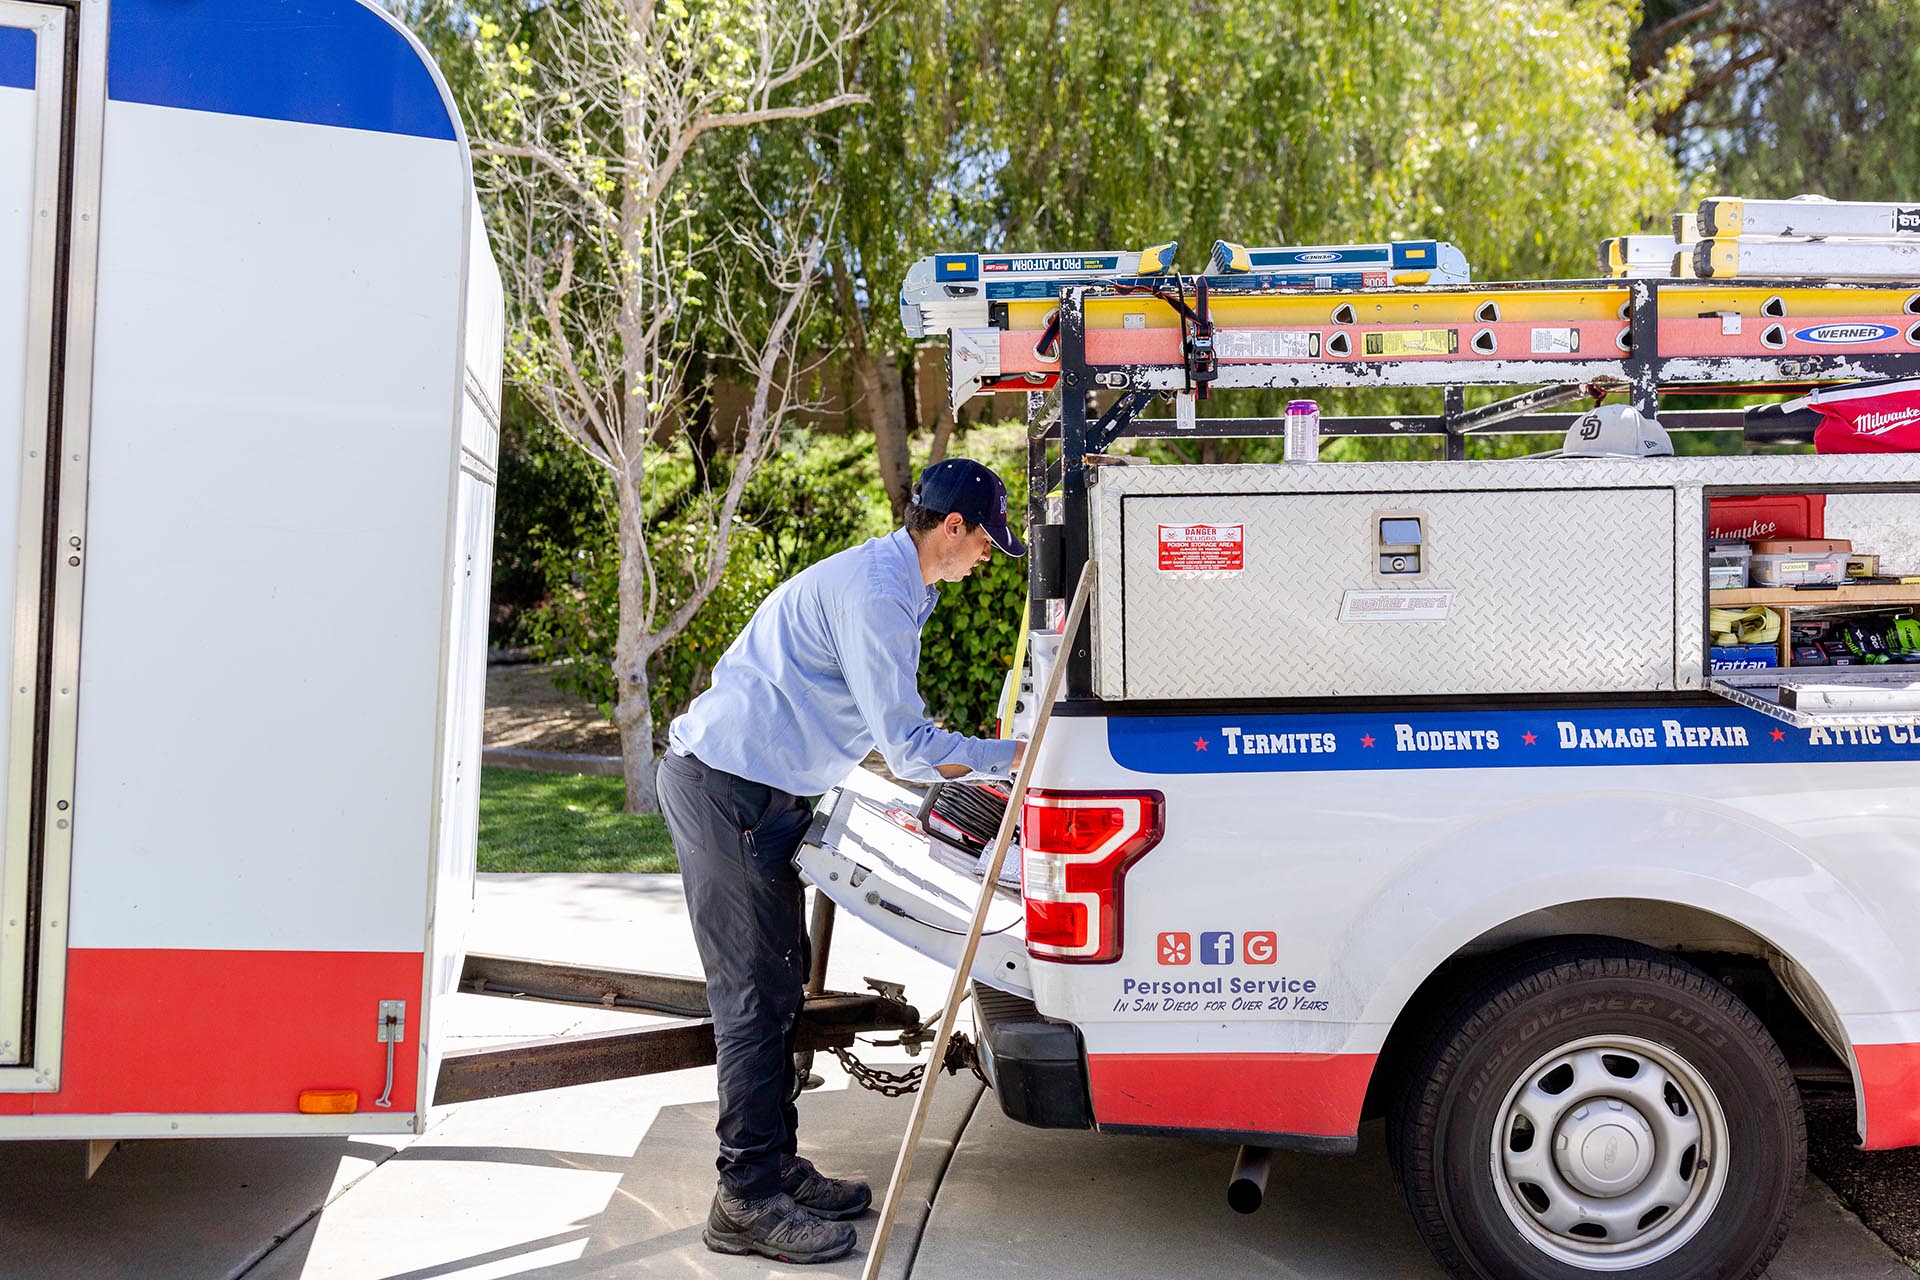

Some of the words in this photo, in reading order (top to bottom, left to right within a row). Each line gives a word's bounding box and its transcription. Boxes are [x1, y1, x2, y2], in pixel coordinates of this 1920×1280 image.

[1012, 259, 1060, 271] PLATFORM
[1062, 258, 1081, 270] PRO
[1817, 328, 1878, 339] WERNER
[1185, 528, 1217, 536] DANGER
[1221, 727, 1336, 755] TERMITES
[1394, 723, 1500, 752] RODENTS
[1557, 720, 1657, 750] DAMAGE
[1662, 719, 1749, 749] REPAIR
[1809, 725, 1881, 745] ATTIC
[1123, 977, 1222, 995] Personal
[1230, 976, 1317, 994] Service
[1112, 998, 1129, 1012] IN
[1132, 998, 1158, 1012] SAN
[1162, 997, 1199, 1011] DIEGO
[1204, 999, 1227, 1011] FOR
[1231, 996, 1263, 1011] OVER
[1267, 996, 1288, 1011] 20
[1292, 996, 1329, 1012] YEARS
